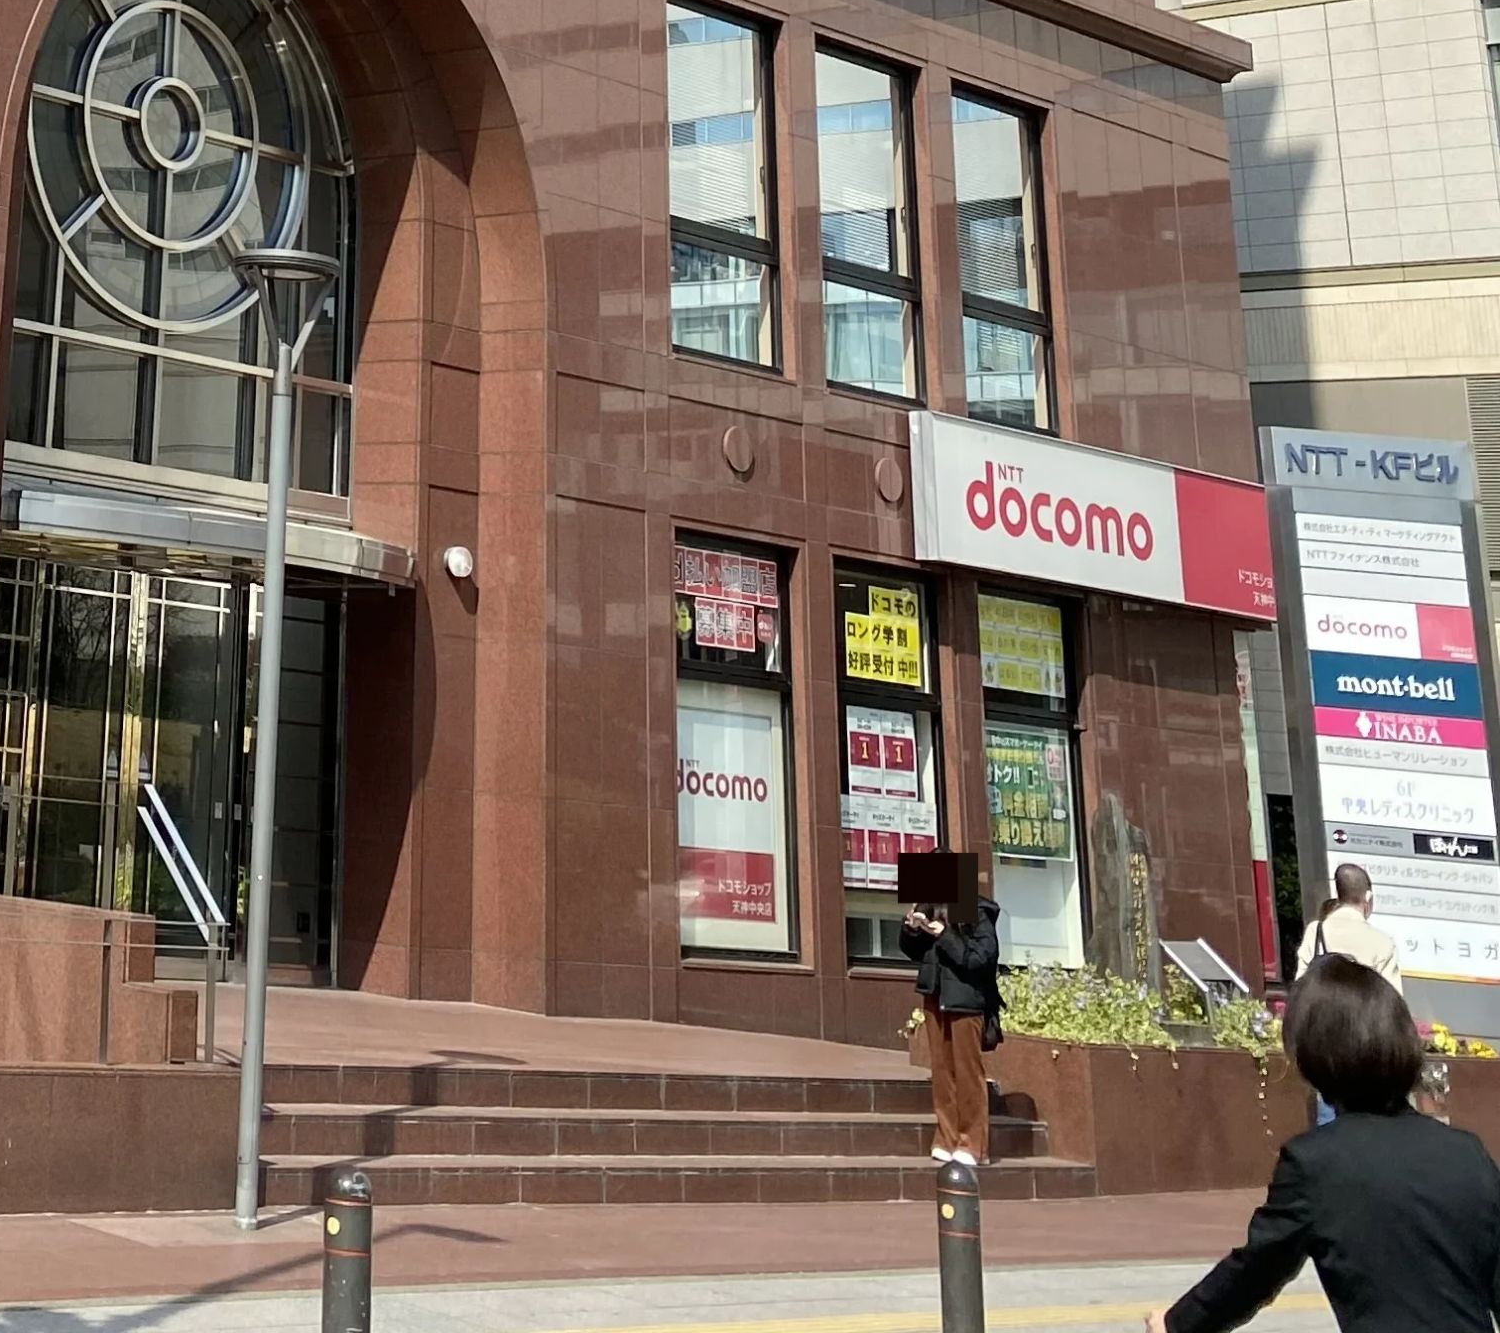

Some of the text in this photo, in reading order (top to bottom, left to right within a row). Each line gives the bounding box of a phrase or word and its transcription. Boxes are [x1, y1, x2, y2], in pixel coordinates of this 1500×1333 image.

[997, 462, 1024, 484] NTT
[966, 460, 1154, 561] docomo
[871, 592, 916, 618] ドコモの
[696, 605, 753, 645] 募集中
[847, 621, 908, 648] ロング学割
[1318, 613, 1408, 640] docomo
[1373, 723, 1443, 744] INABA
[685, 759, 700, 769] NTT
[1341, 796, 1474, 825] 中央レディスクリニック
[718, 878, 773, 897] ドコモショップ
[732, 899, 773, 917] 天神中央店
